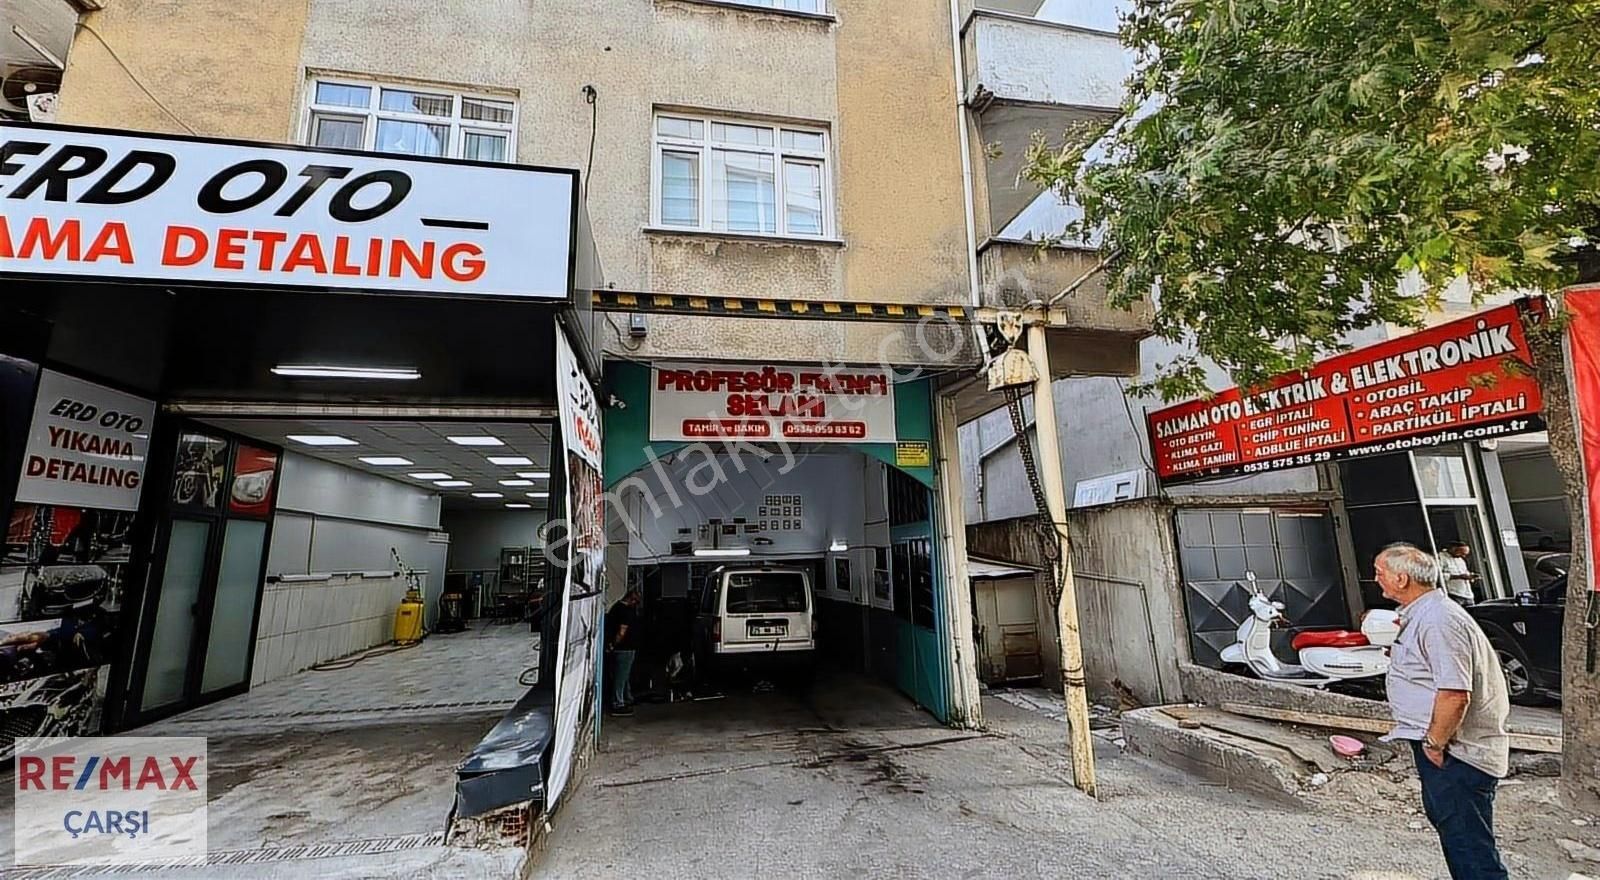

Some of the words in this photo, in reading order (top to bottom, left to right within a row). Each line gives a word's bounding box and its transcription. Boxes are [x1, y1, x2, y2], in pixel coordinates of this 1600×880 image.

[197, 159, 412, 223] OTO
[0, 215, 134, 264] MA
[161, 225, 487, 282] DETALING
[657, 366, 796, 393] PROFESÖR
[1156, 409, 1210, 439] SALMAN
[1211, 400, 1242, 425] OTO
[1331, 373, 1350, 395] &
[1350, 320, 1517, 390] ELEKTRONİK
[1366, 379, 1427, 404] OTOBİL
[50, 399, 97, 421] ERD
[100, 411, 143, 433] OTO
[1250, 417, 1273, 430] EGR
[1276, 403, 1313, 424] İPTALİ
[1369, 400, 1415, 420] ARAÇ
[1418, 386, 1473, 411] TAKİP
[1372, 408, 1457, 436] PARTİKÜL
[1461, 393, 1526, 421] İPTALİ
[48, 425, 134, 456] YIKAMA
[1252, 427, 1279, 443] CHİP
[1282, 419, 1330, 437] TUNİNG
[1254, 440, 1301, 458] ADBLUE
[1304, 428, 1346, 448] İPTALİ
[1200, 441, 1223, 453] GAZI
[1243, 461, 1270, 473] 0535
[1272, 457, 1294, 468] 575
[1296, 454, 1312, 465] 35
[1314, 451, 1331, 462] 29
[26, 455, 140, 489] DETALING
